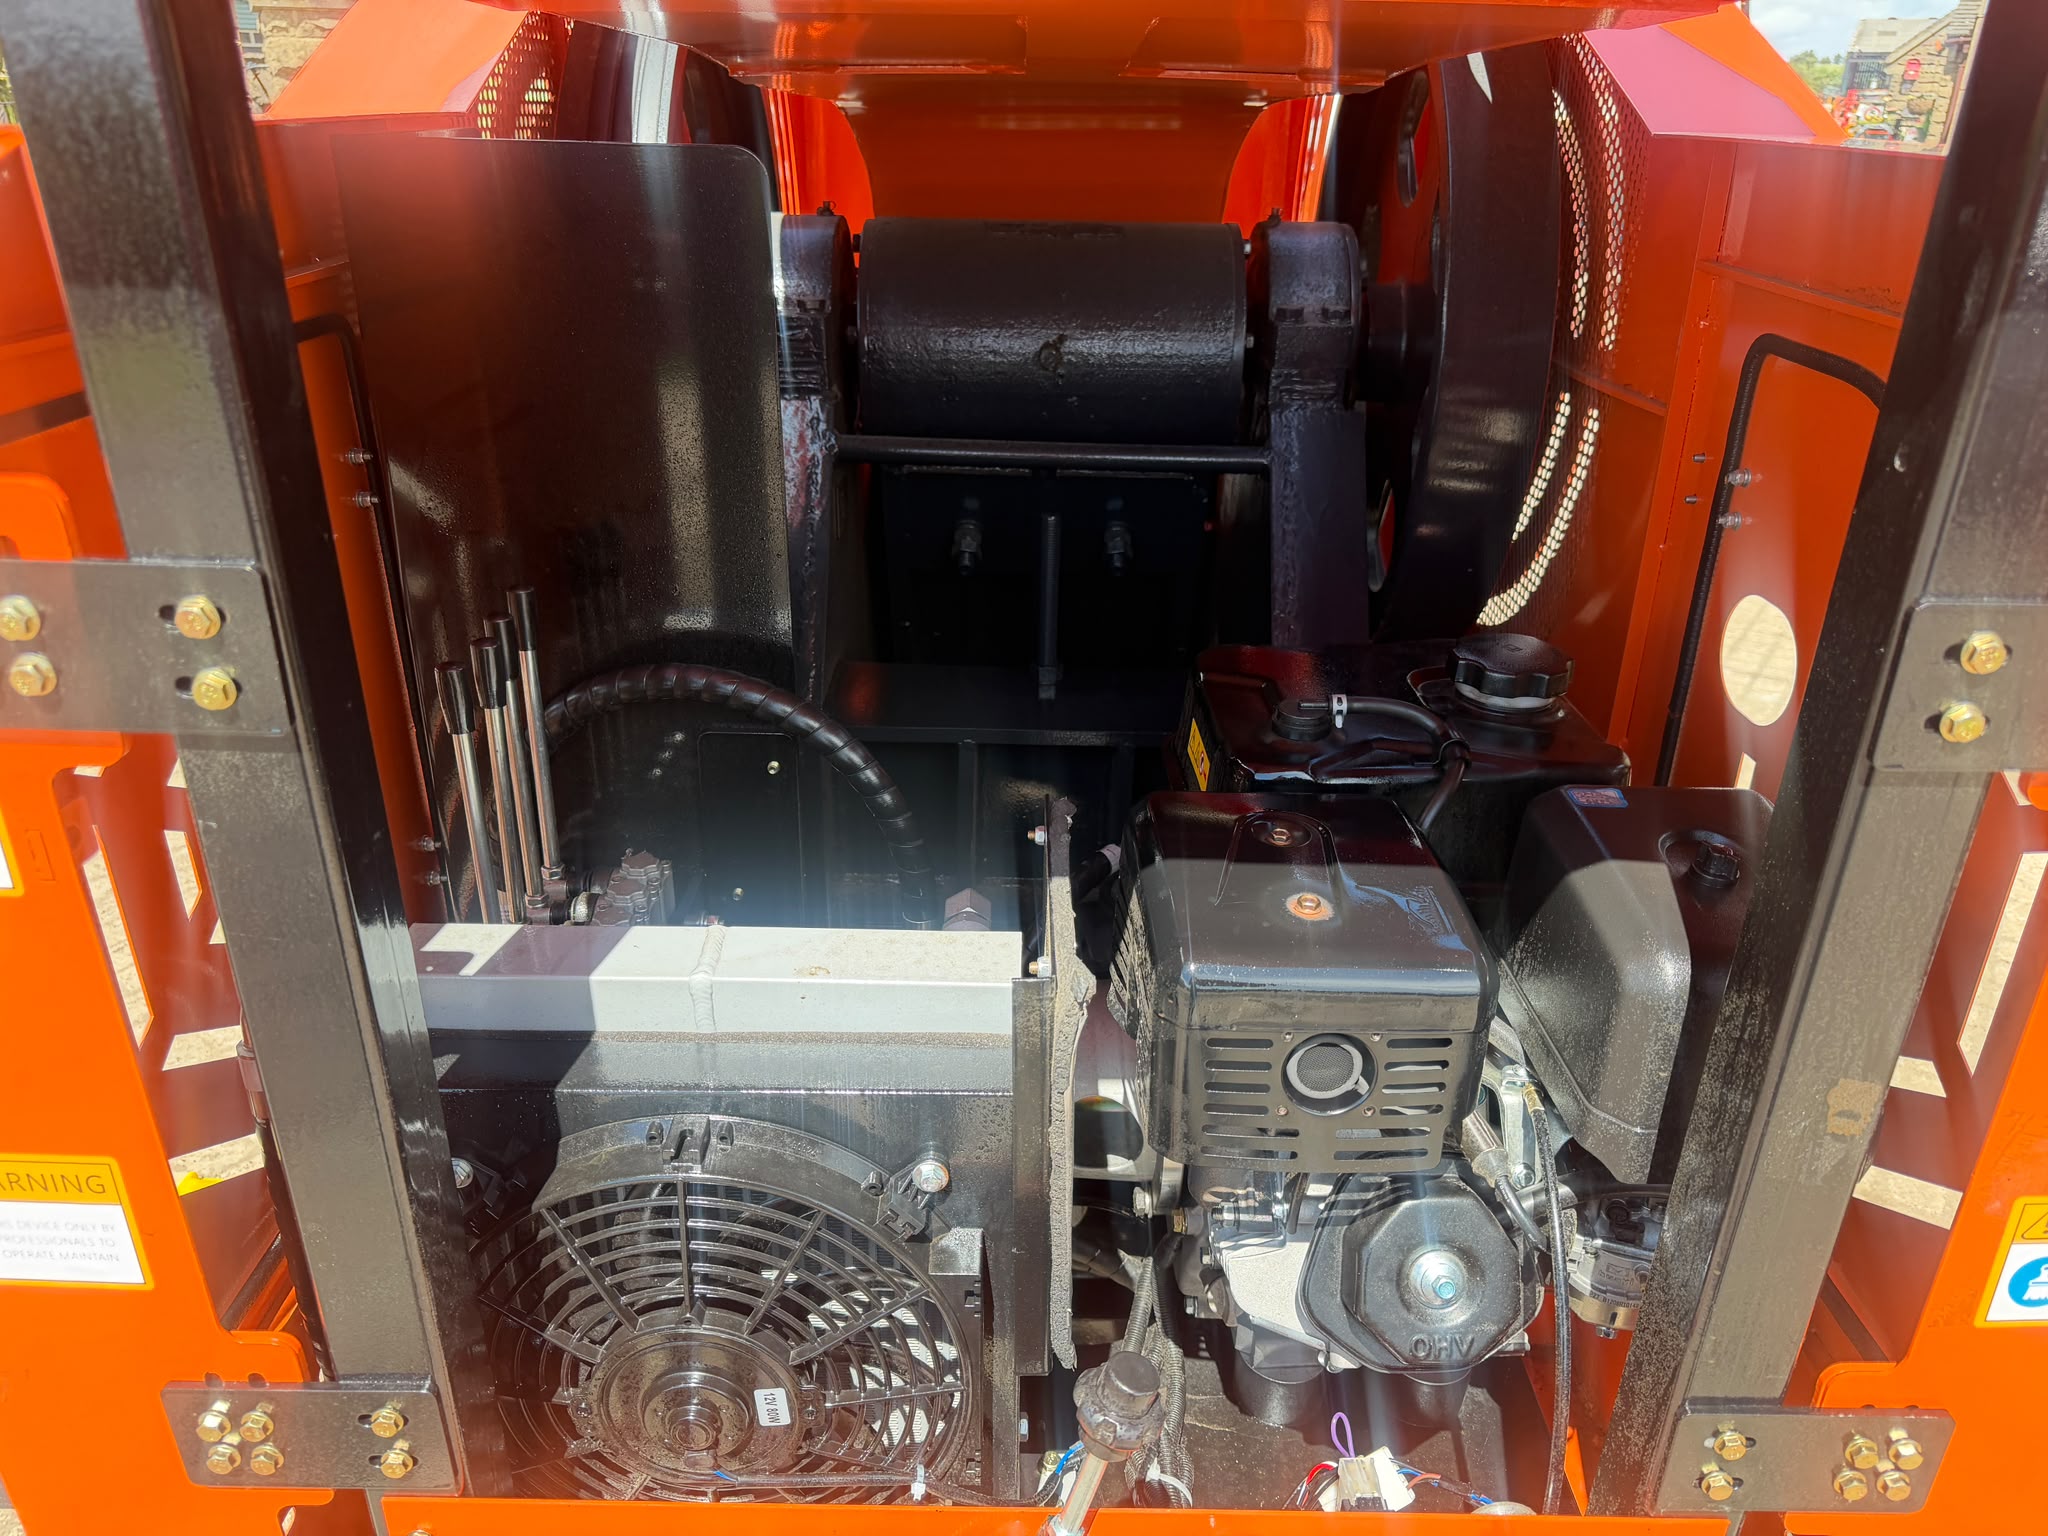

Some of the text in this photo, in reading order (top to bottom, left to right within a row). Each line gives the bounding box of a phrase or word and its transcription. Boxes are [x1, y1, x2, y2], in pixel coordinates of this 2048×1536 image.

[1409, 1333, 1475, 1360] OHV
[763, 1392, 781, 1424] 12V 80W
